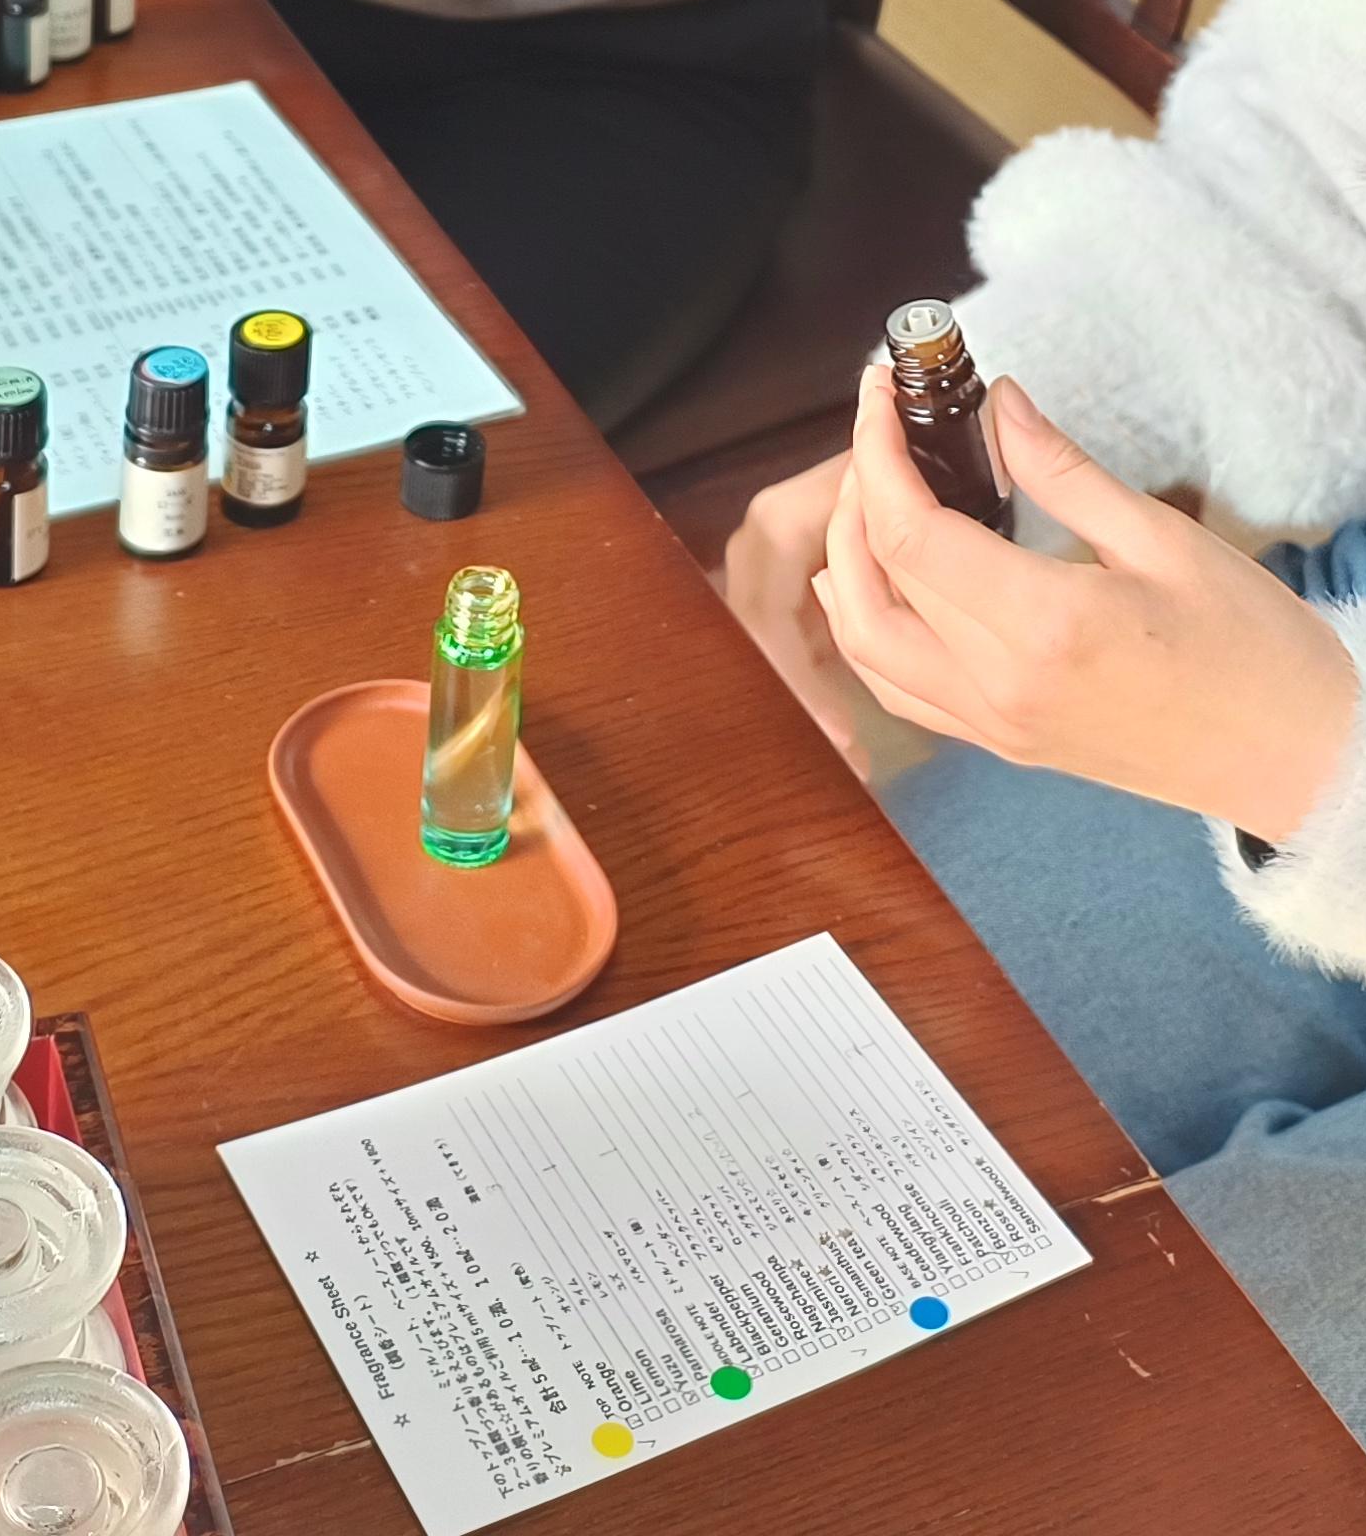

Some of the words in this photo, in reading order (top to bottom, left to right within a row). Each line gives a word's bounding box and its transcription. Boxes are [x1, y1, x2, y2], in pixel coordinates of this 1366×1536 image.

[904, 1183, 972, 1266] Frankincense
[962, 1198, 1006, 1249] Benzoin
[980, 1165, 1040, 1233] Sandalwood
[844, 1237, 865, 1259] tea
[871, 1203, 936, 1281] Ceaderwood
[876, 1236, 900, 1261] NOTE
[897, 1203, 953, 1274] Ylangylang
[939, 1198, 991, 1258] Patchouli
[993, 1209, 1024, 1242] Rose
[317, 1275, 350, 1318] Sheet
[767, 1254, 830, 1332] Nagchampa
[799, 1270, 843, 1323] Jasmine
[822, 1241, 878, 1307] Osmanthus
[824, 1275, 862, 1317] Nerori
[863, 1260, 895, 1299] Green
[896, 1262, 921, 1288] BASE
[685, 1304, 709, 1331] NOTE
[708, 1274, 771, 1355] Blackpepper
[739, 1283, 789, 1347] Geranium
[751, 1271, 808, 1340] Rosewood
[655, 1308, 707, 1381] Parmarosa
[703, 1301, 753, 1363] Labender
[345, 1321, 394, 1399] Fragrance
[572, 1360, 595, 1389] NOTE
[634, 1348, 671, 1397] Lemon
[660, 1353, 688, 1390] Yuzu
[595, 1361, 632, 1412] Orange
[595, 1397, 615, 1419] TOP
[624, 1370, 652, 1405] Lime
